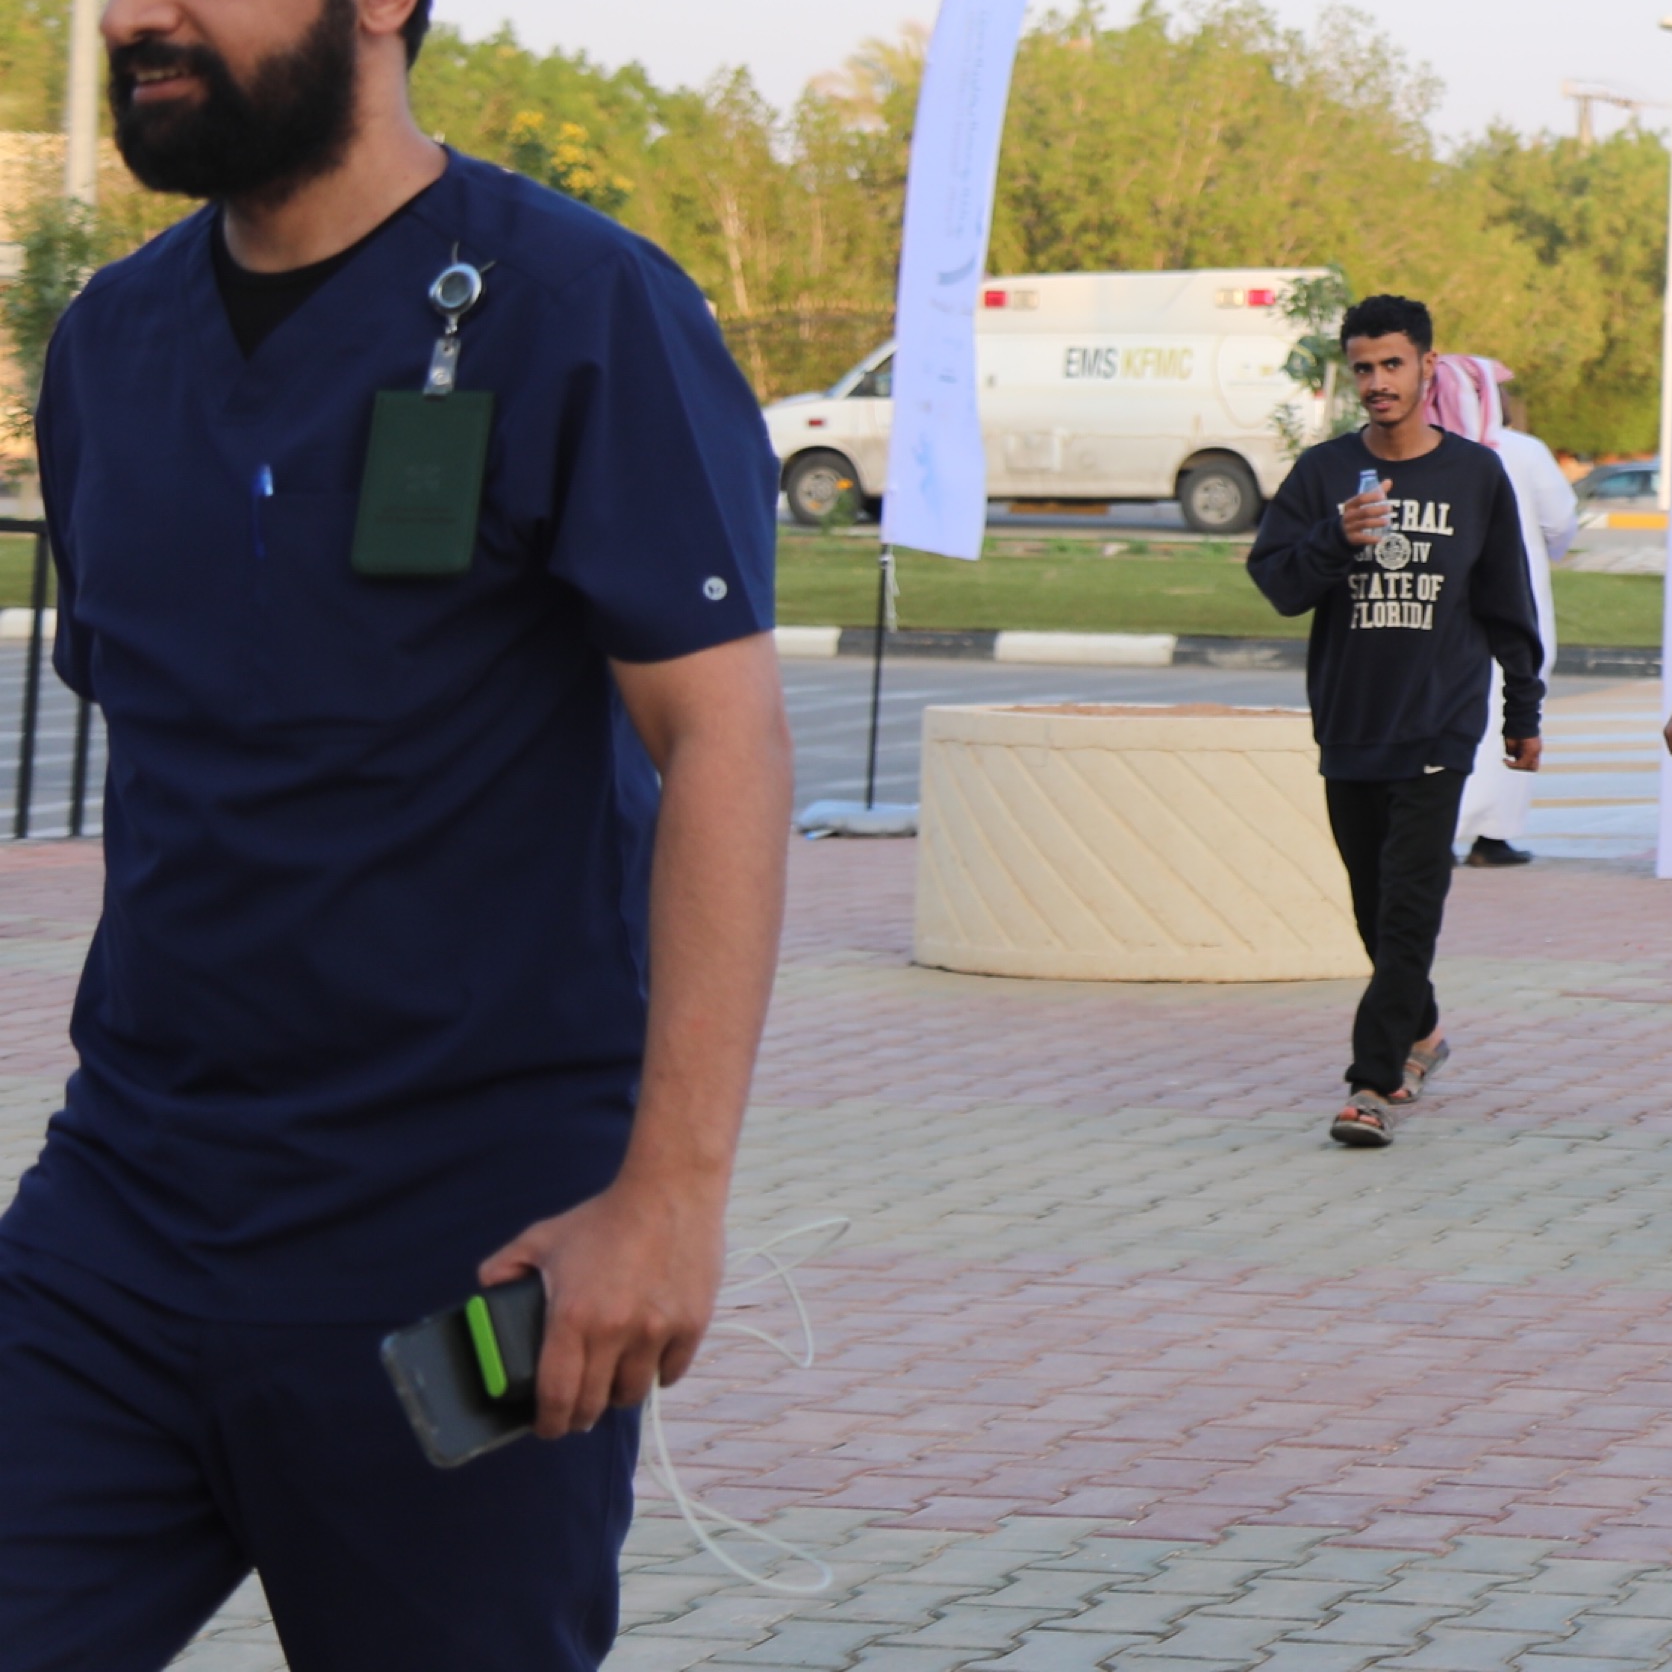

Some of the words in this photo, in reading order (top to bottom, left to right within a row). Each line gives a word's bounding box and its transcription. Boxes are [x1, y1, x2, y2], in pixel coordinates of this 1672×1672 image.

[1063, 345, 1118, 379] EMS
[1122, 345, 1194, 380] KFMC
[1337, 499, 1455, 537] ERAL
[1411, 542, 1432, 564] IV
[1347, 572, 1414, 600] STATE
[1417, 574, 1445, 602] OF
[1350, 601, 1434, 631] FLORIDA
